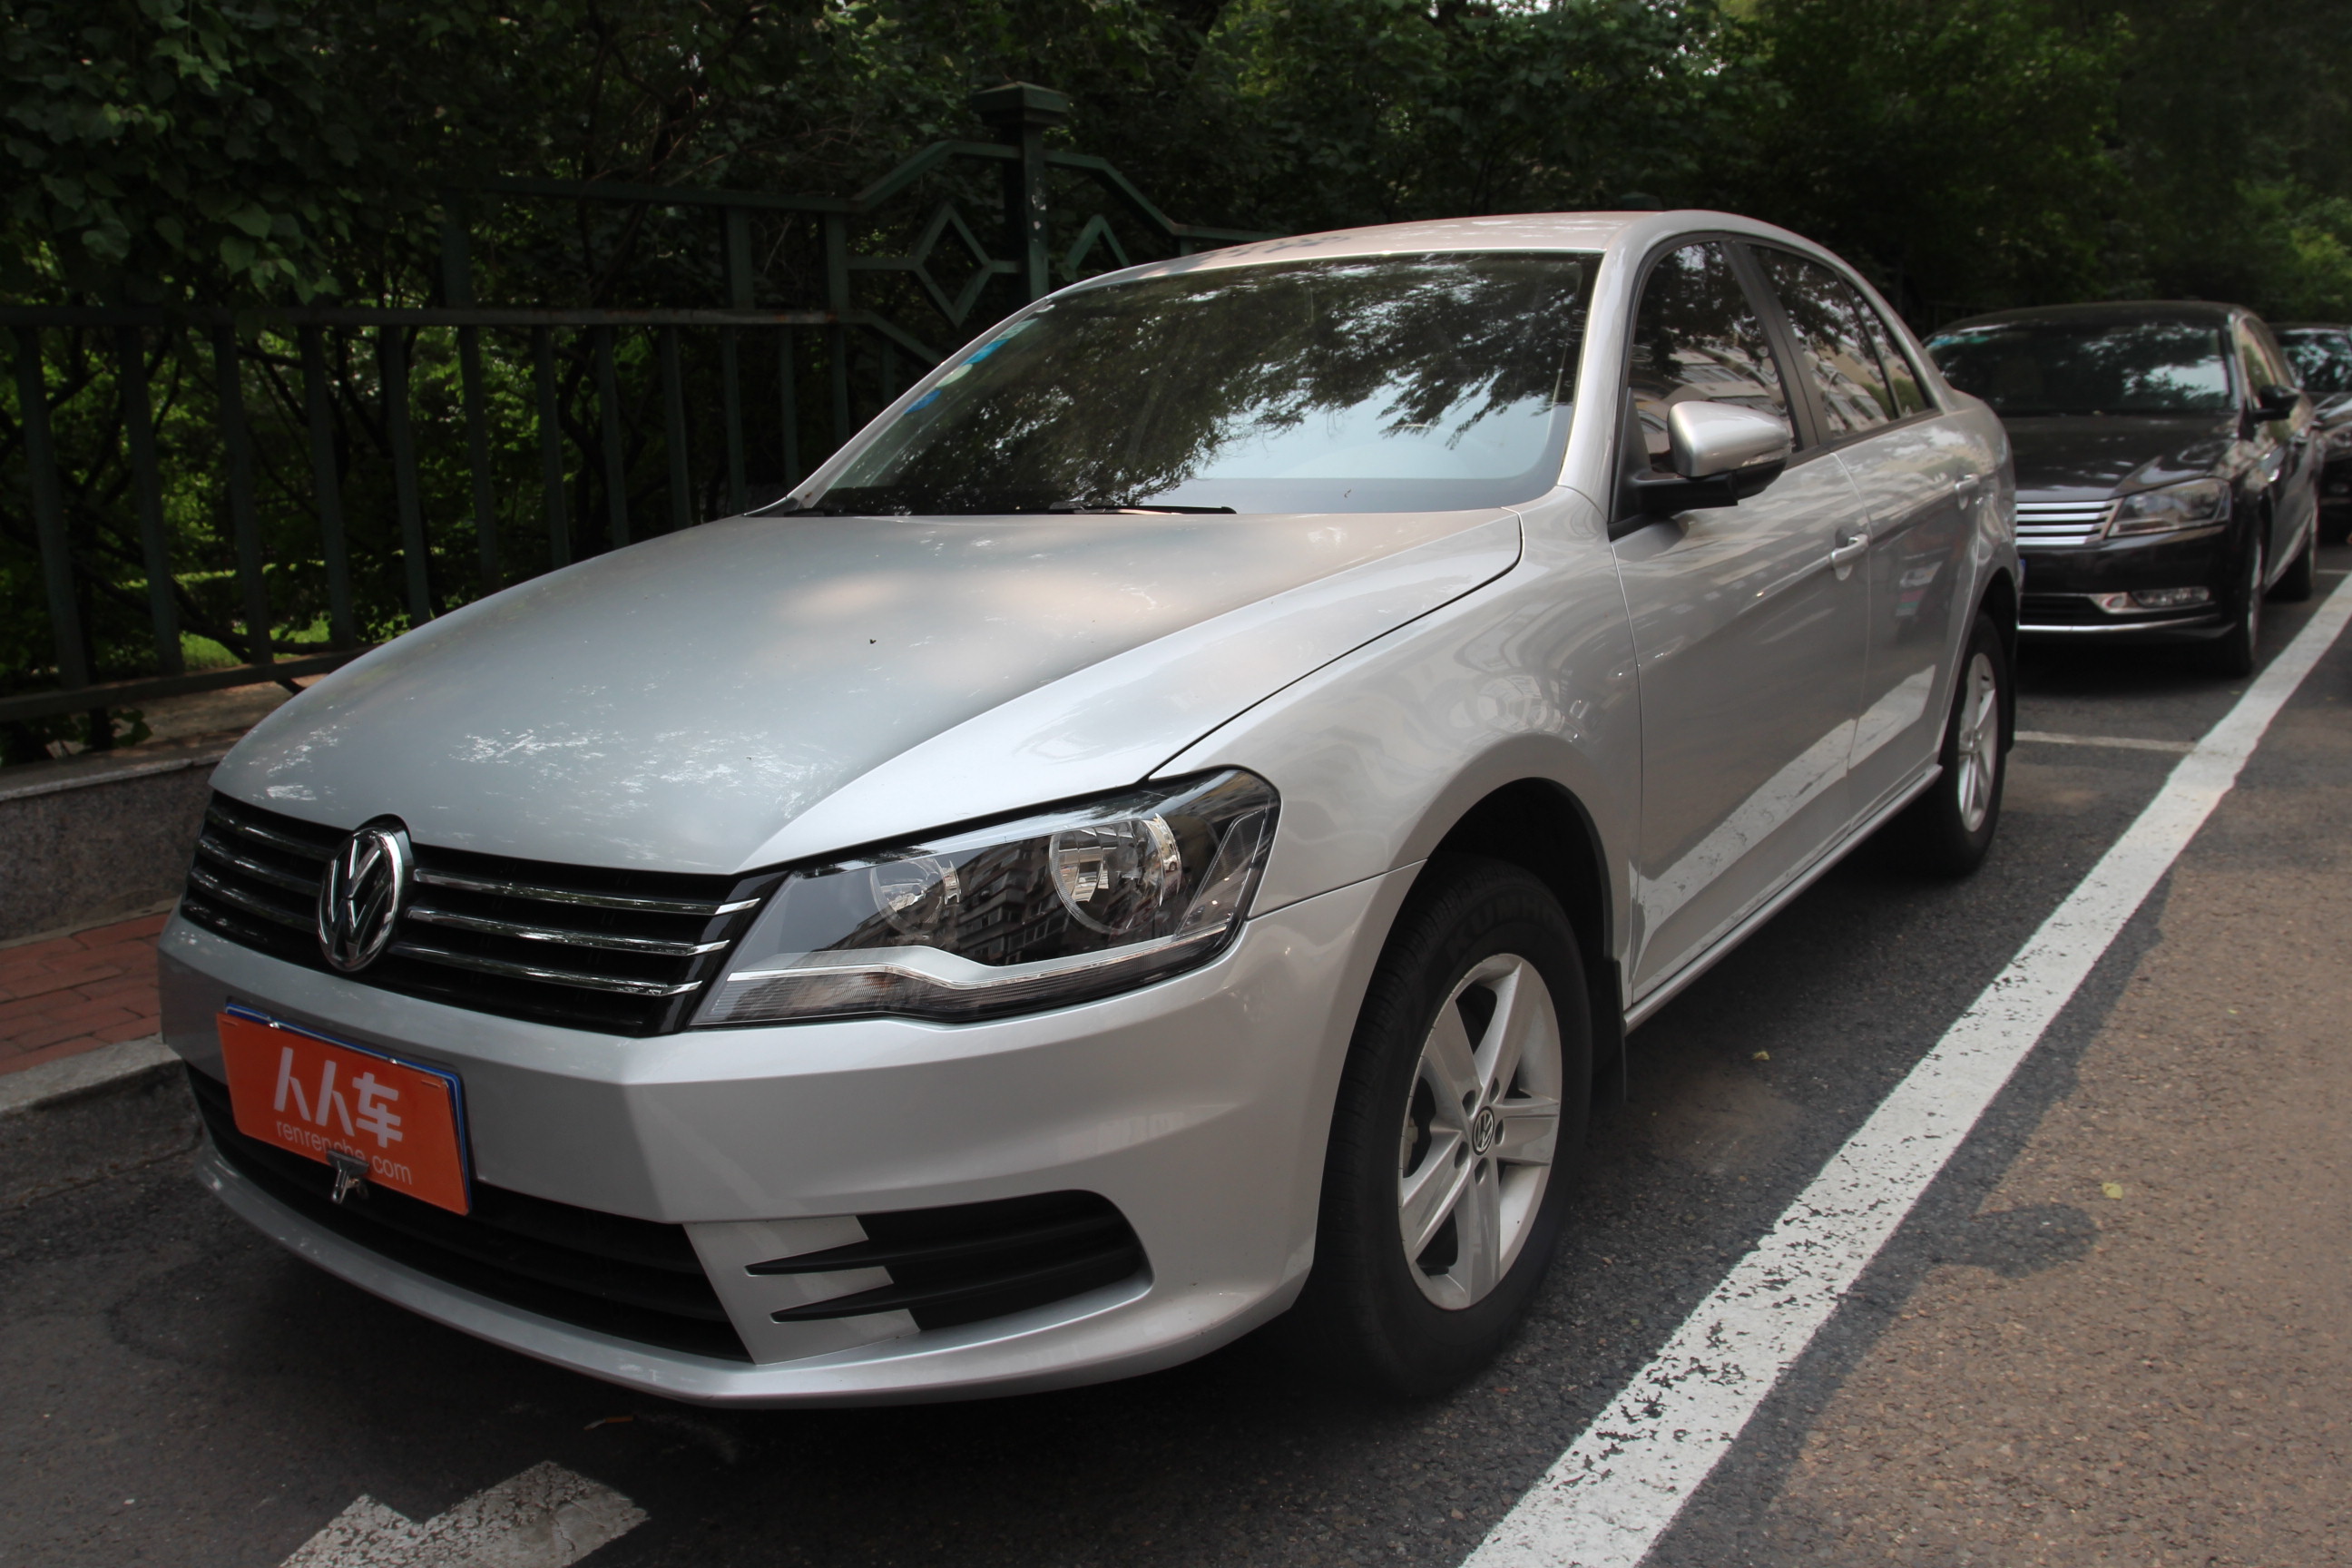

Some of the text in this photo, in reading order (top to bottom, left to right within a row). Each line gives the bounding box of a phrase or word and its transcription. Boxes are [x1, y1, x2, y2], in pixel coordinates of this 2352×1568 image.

[273, 1046, 403, 1148] 人人车
[276, 1121, 412, 1185] renrenchecom
